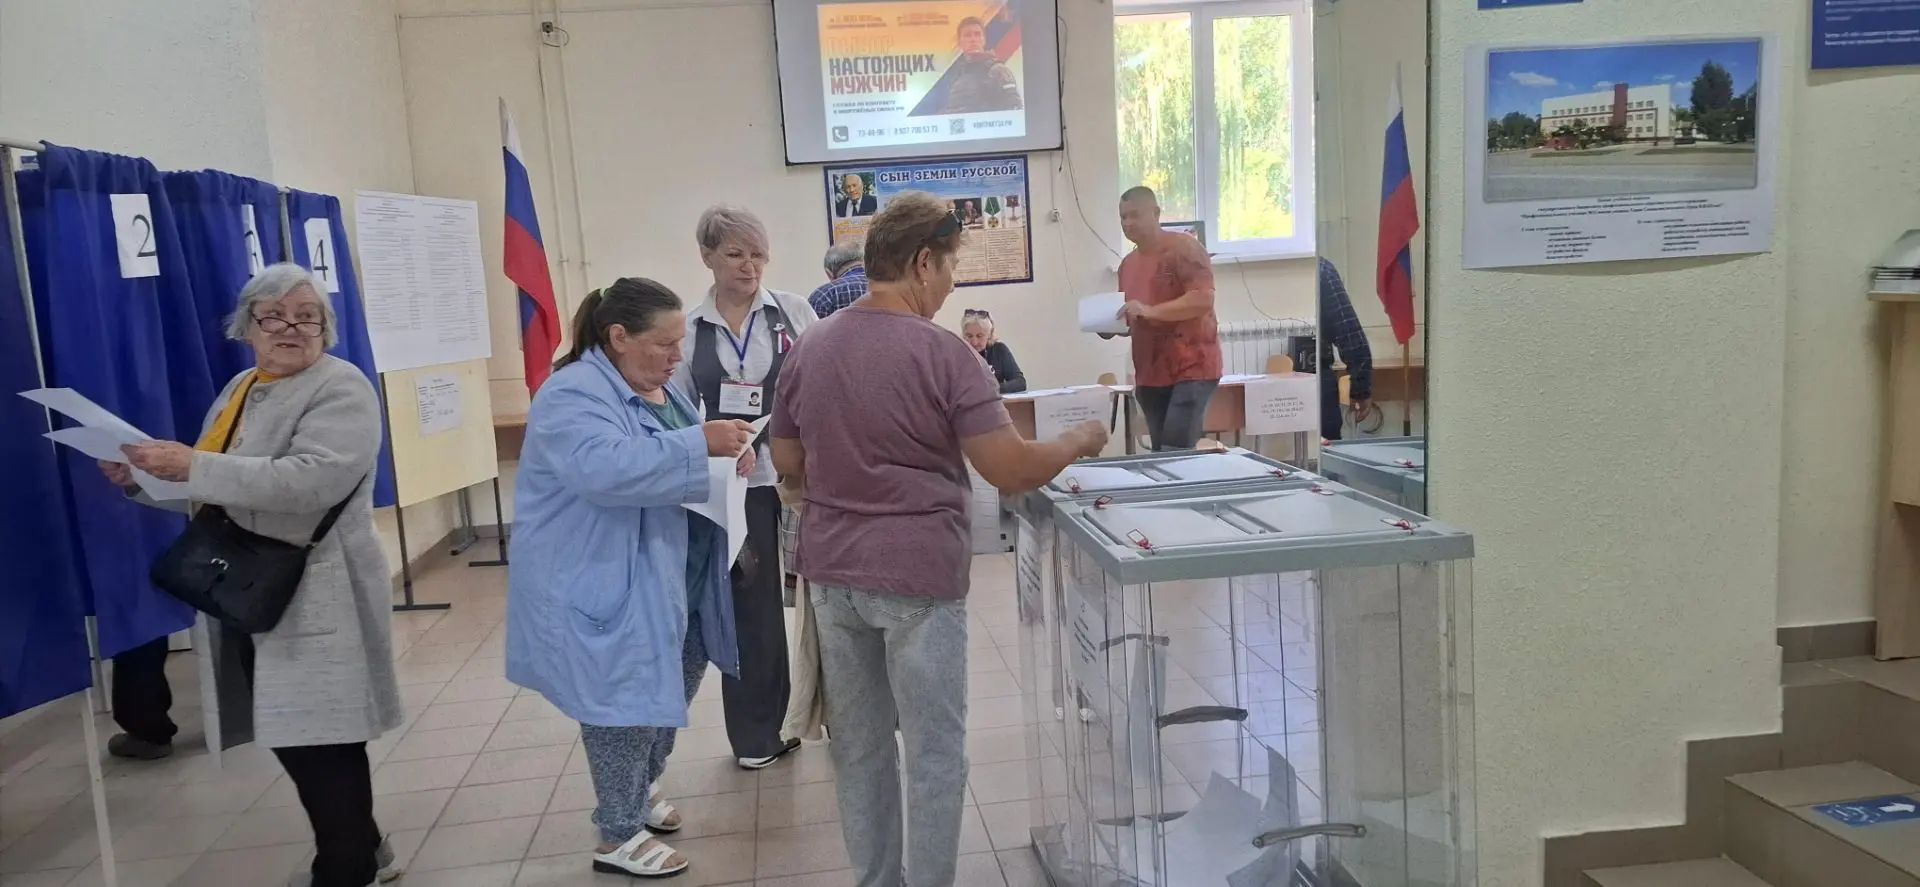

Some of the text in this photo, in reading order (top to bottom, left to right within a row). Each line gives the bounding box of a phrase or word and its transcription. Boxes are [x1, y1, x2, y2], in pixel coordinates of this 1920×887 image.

[828, 53, 936, 76] НАСТОЯЩИХ
[830, 73, 907, 95] МУЖЧИН
[880, 163, 1017, 183] СЫН ЗЕМЛИ РУССКОЙ
[132, 213, 157, 258] 2
[313, 239, 329, 282] 4
